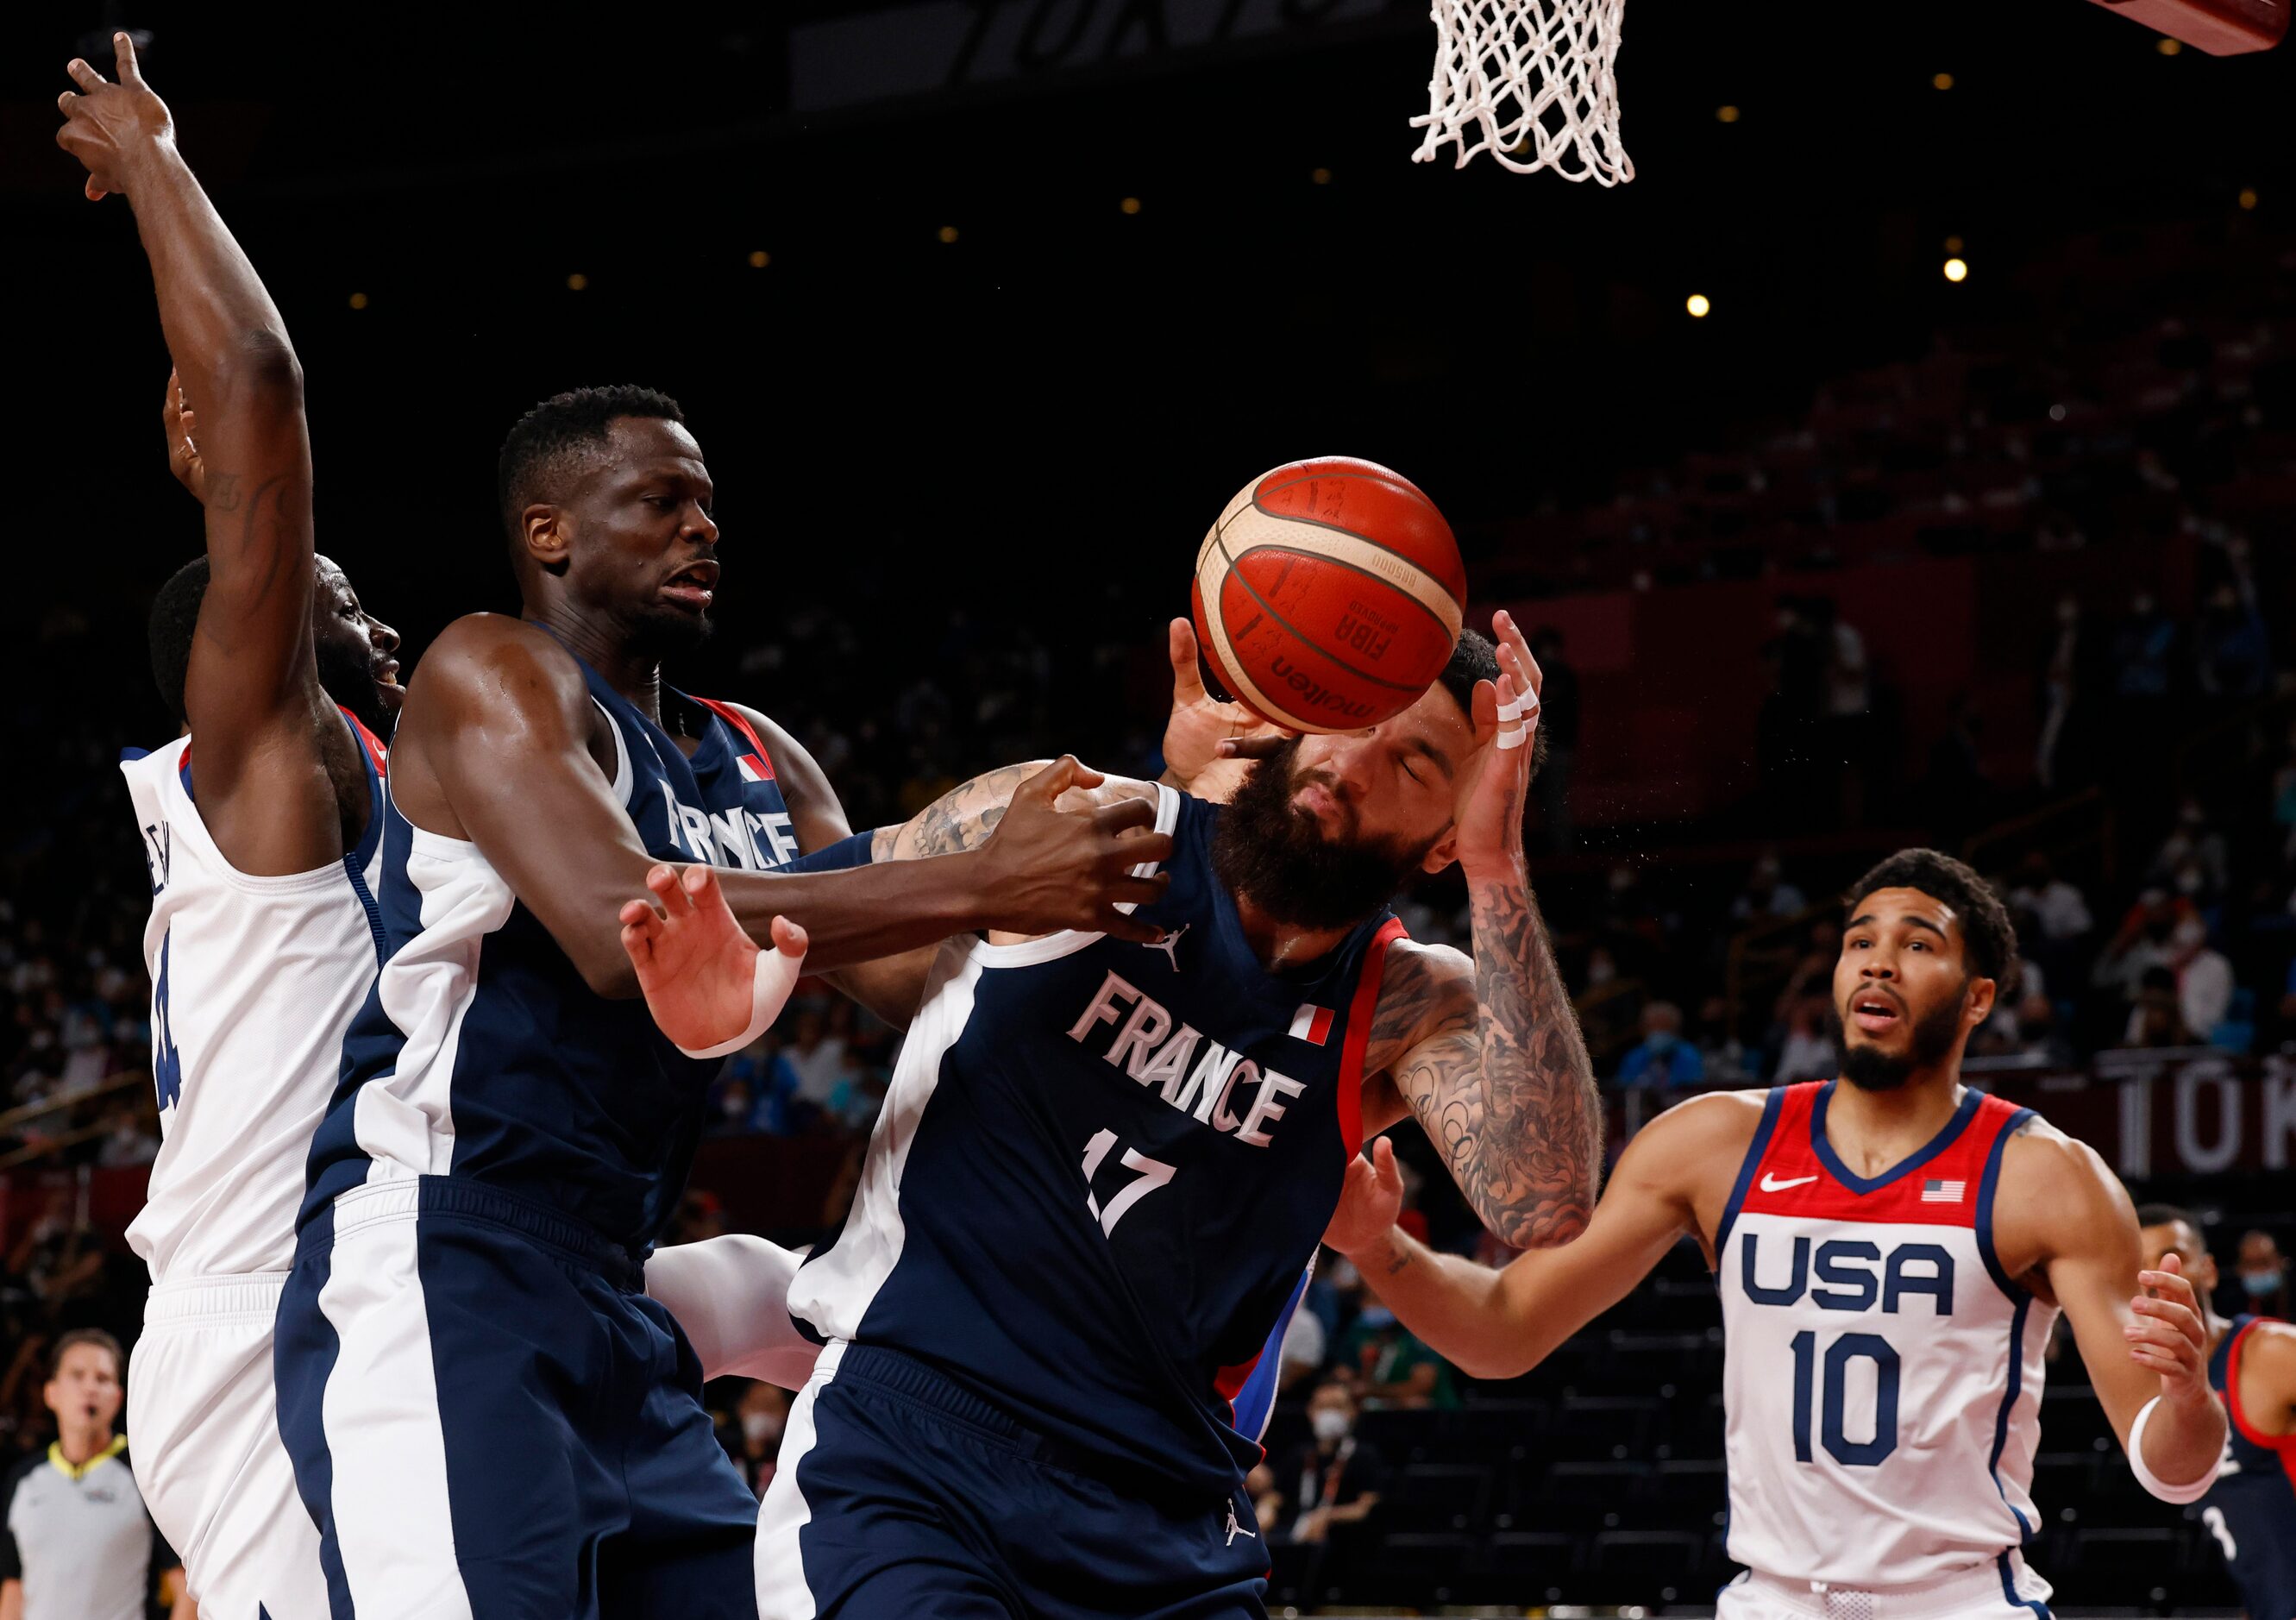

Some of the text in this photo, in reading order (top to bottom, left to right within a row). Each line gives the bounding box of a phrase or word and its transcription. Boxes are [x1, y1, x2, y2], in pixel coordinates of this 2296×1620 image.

[1334, 613, 1392, 662] FIBA
[1349, 600, 1400, 635] APPROVED
[1270, 655, 1377, 719] molten
[658, 778, 799, 870] FRNCE
[1066, 968, 1308, 1148] FRANCE
[1081, 1127, 1178, 1240] 17
[1742, 1234, 1954, 1315] USA
[1790, 1330, 1901, 1466] 10
